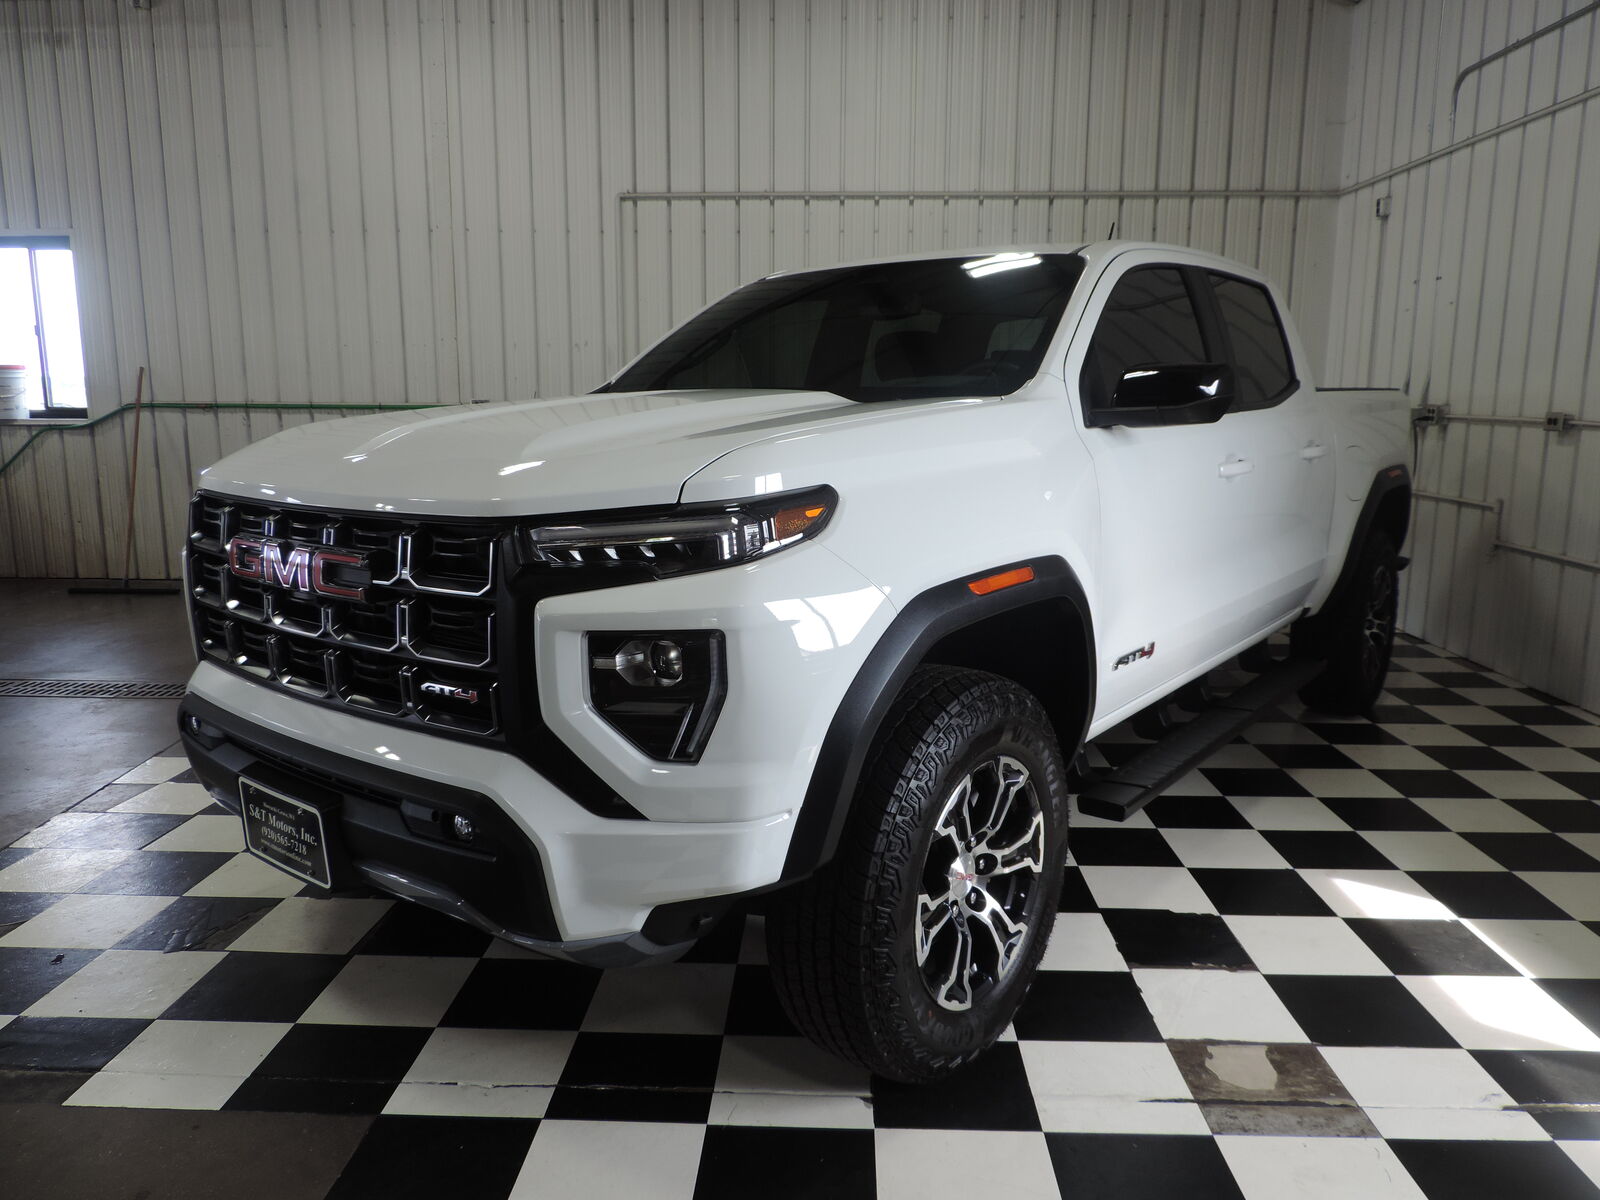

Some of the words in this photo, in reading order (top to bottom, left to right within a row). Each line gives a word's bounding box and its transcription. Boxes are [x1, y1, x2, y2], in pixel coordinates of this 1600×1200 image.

[229, 535, 367, 601] GMC
[1111, 641, 1155, 671] AT4
[420, 682, 478, 704] AT4
[249, 803, 267, 822] S&T
[268, 812, 299, 840] Motors,
[301, 827, 318, 847] Inc.
[261, 826, 307, 856] (920)565-7218
